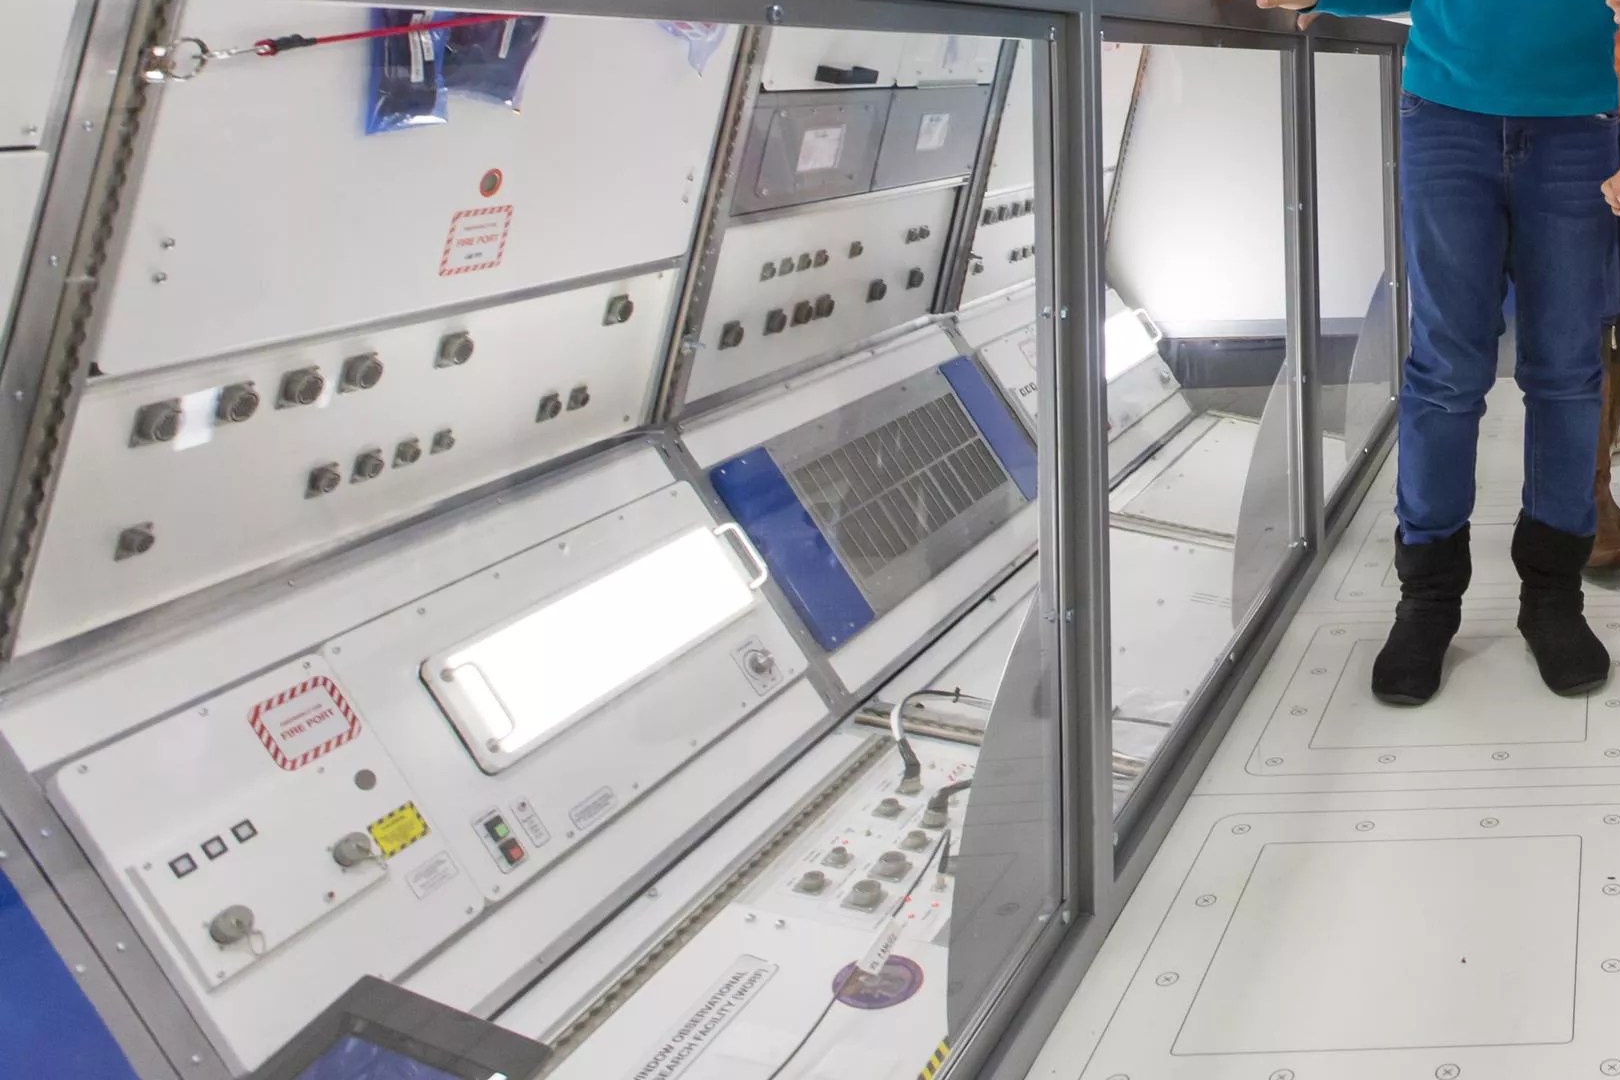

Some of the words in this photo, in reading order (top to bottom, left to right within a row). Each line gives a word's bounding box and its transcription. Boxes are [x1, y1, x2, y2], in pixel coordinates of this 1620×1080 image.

[280, 724, 305, 740] FIRE
[305, 709, 335, 728] PORT
[671, 970, 749, 1043] OBSERVATIONAL
[693, 1000, 736, 1042] FACILITY
